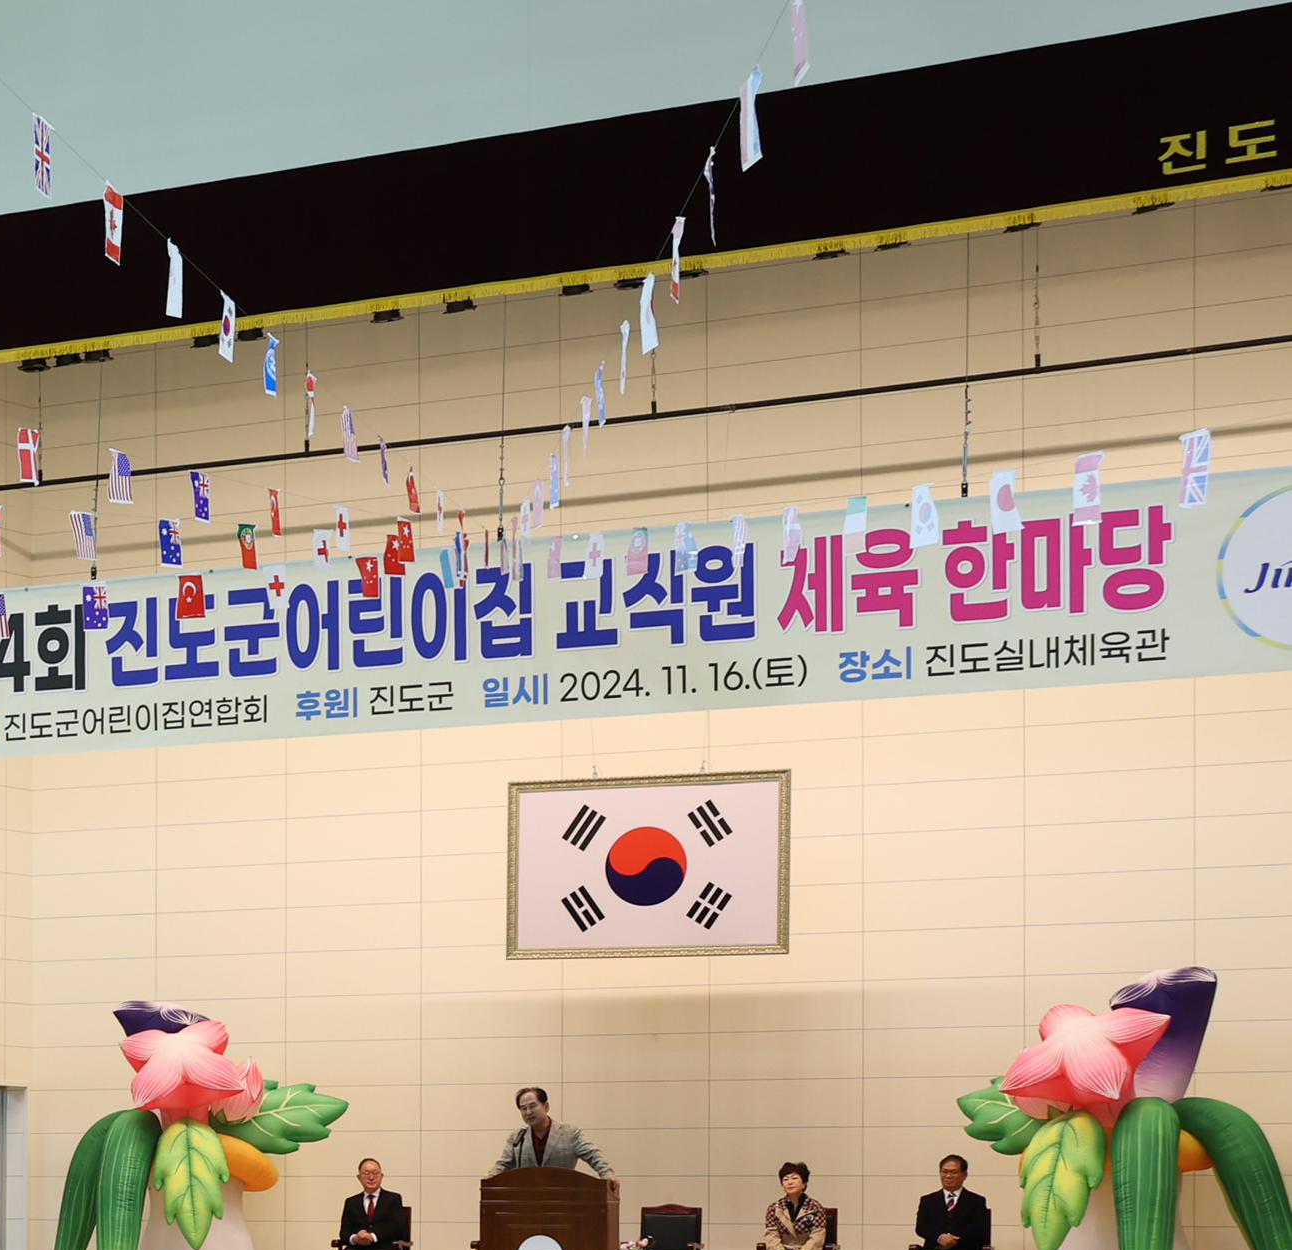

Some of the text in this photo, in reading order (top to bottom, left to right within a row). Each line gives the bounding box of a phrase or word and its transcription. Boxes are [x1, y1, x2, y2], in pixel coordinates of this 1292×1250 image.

[1157, 119, 1278, 175] 진도
[106, 562, 533, 687] 진도군어린이집
[777, 528, 919, 632] 체육
[942, 505, 1172, 622] 한마당
[4, 694, 268, 742] 진도군어린이집연합회
[369, 681, 454, 716] 진도군
[559, 668, 651, 702] 2024.
[662, 665, 697, 695] 11.
[708, 654, 808, 692] 16.(토)
[925, 628, 1171, 677] 진도실내체육관
